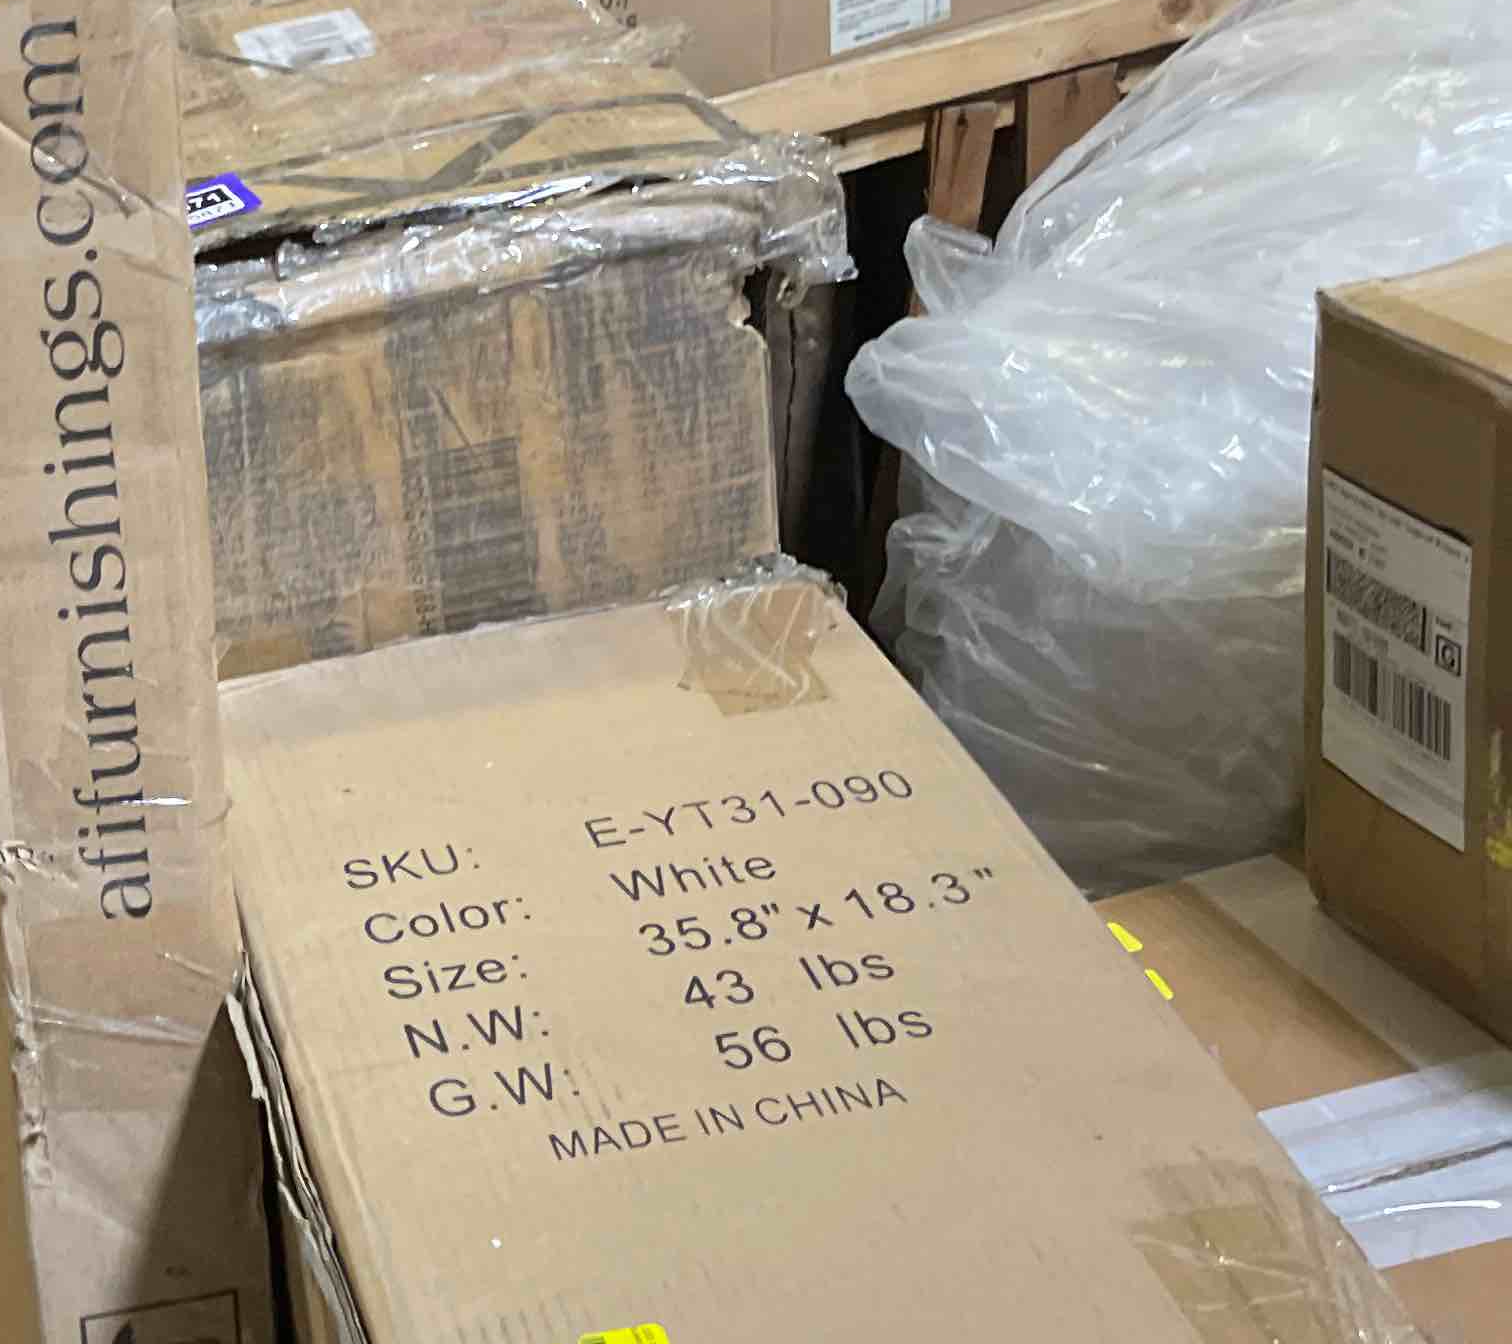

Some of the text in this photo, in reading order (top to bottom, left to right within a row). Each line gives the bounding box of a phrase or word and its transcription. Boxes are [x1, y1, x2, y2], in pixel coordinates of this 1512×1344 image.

[19, 16, 153, 921] afifurnishings.com
[343, 769, 912, 891] SKU: E-YT31-090
[364, 854, 777, 944] Color: White
[384, 953, 529, 1001] Size:
[638, 902, 781, 957] 35.8"
[845, 867, 994, 920] 18.3"
[683, 968, 755, 1011] 43
[799, 951, 895, 991] lbs
[714, 1025, 791, 1071] 56
[835, 1007, 934, 1049] lbs
[548, 1077, 908, 1162] MADE IN CHINA
